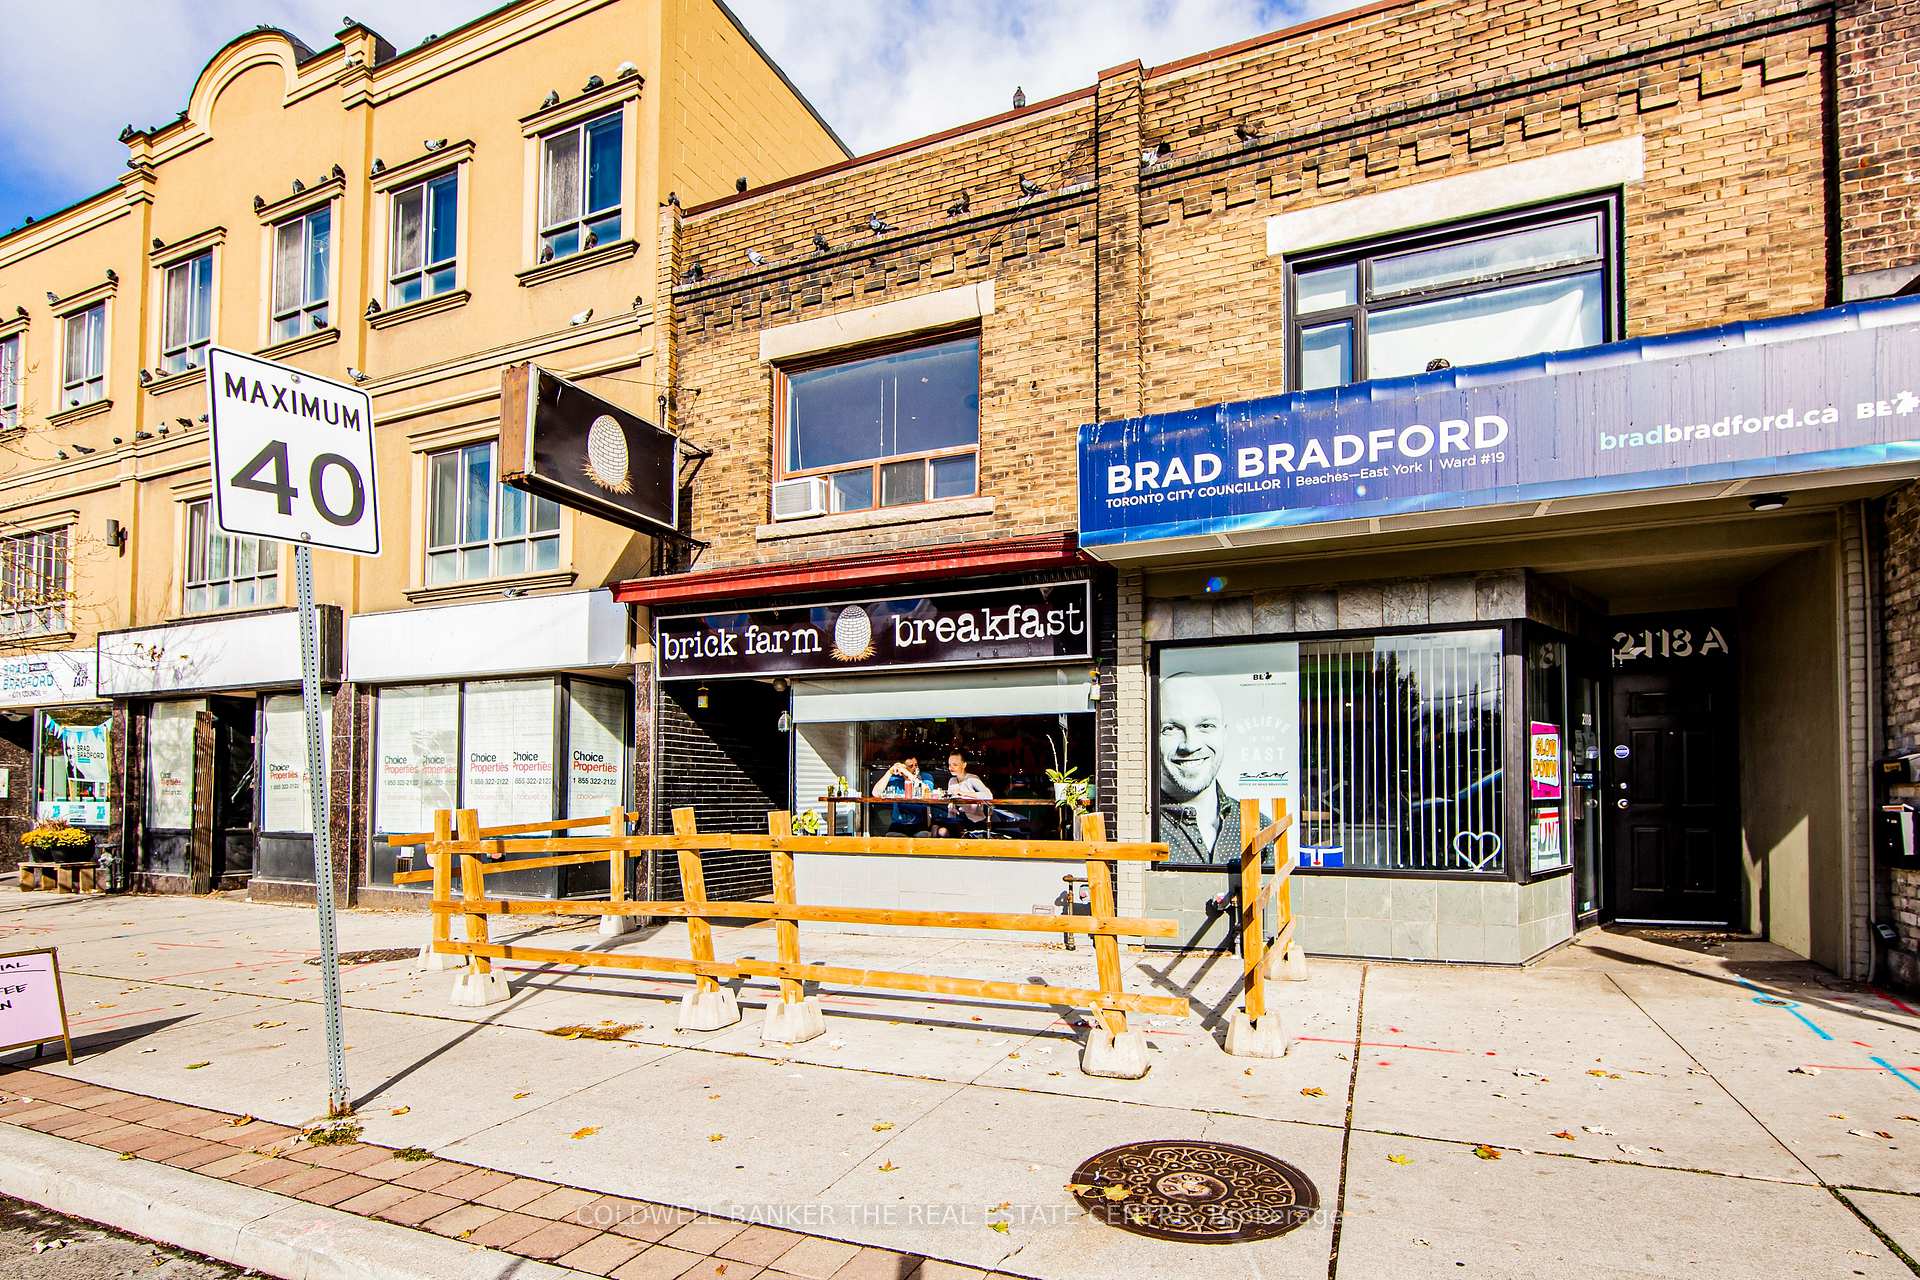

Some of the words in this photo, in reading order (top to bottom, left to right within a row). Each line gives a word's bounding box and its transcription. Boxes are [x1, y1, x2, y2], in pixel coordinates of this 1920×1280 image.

[225, 372, 360, 432] MAXIMUM
[1600, 405, 1839, 450] bradbradford.ca
[1107, 453, 1222, 494] BRAD
[1237, 415, 1508, 478] BRADFORD
[231, 440, 365, 526] 40
[1106, 492, 1164, 508] TORONTO
[1167, 488, 1194, 502] CITY
[1198, 479, 1281, 499] COUNCILLOR
[1392, 461, 1423, 476] York
[1440, 455, 1477, 470] Ward
[1480, 451, 1506, 466] #19
[891, 602, 1085, 648] breakfast
[662, 628, 737, 661] brick
[744, 625, 822, 656] farm
[77, 751, 105, 759] BRADFORD
[384, 755, 407, 765] Choice
[470, 753, 497, 763] Choice
[573, 750, 604, 762] Choice
[1241, 746, 1286, 761] EAST
[470, 762, 509, 774] Properties
[573, 761, 618, 774] Properties
[577, 777, 589, 785] 855
[589, 777, 617, 786] 322-2122
